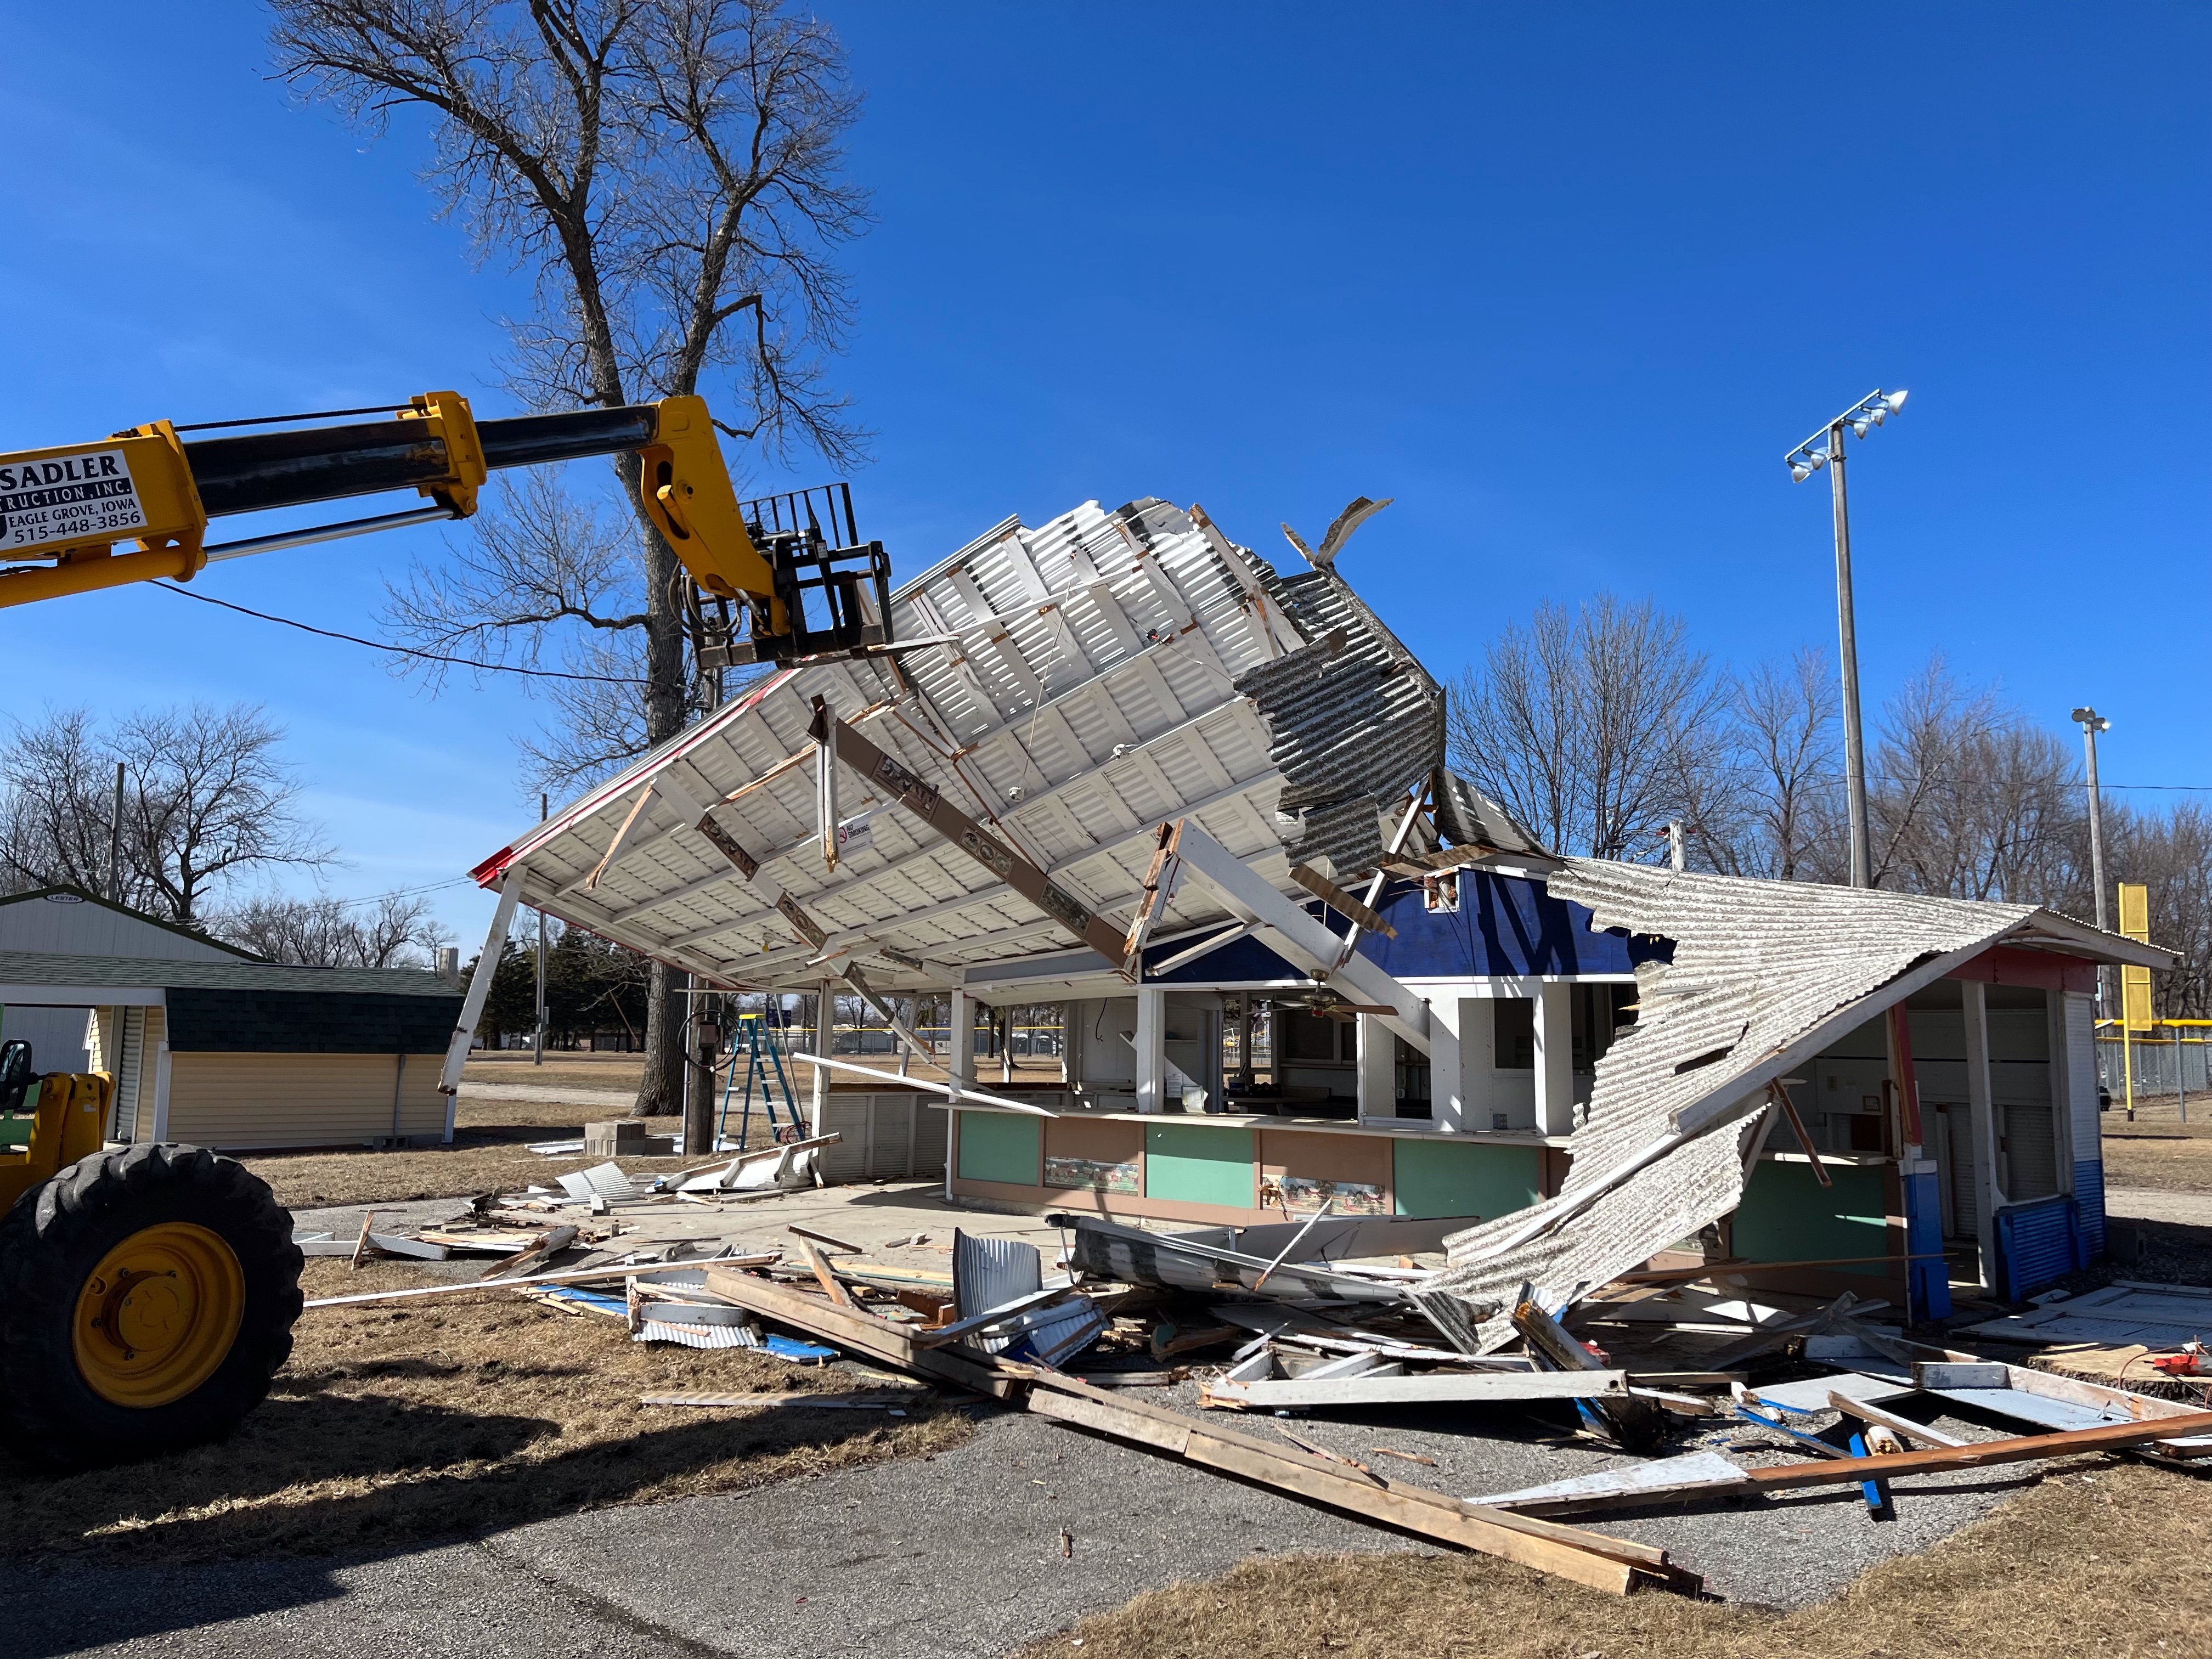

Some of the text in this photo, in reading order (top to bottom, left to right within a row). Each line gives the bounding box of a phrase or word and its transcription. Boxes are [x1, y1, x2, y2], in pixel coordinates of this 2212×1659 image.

[0, 455, 120, 490] SADLER
[0, 487, 84, 511] RUCTION
[8, 498, 136, 528] EAGLE GROVE, IOWA
[15, 511, 140, 543] 515-448-3856
[848, 825, 870, 838] SMOKING
